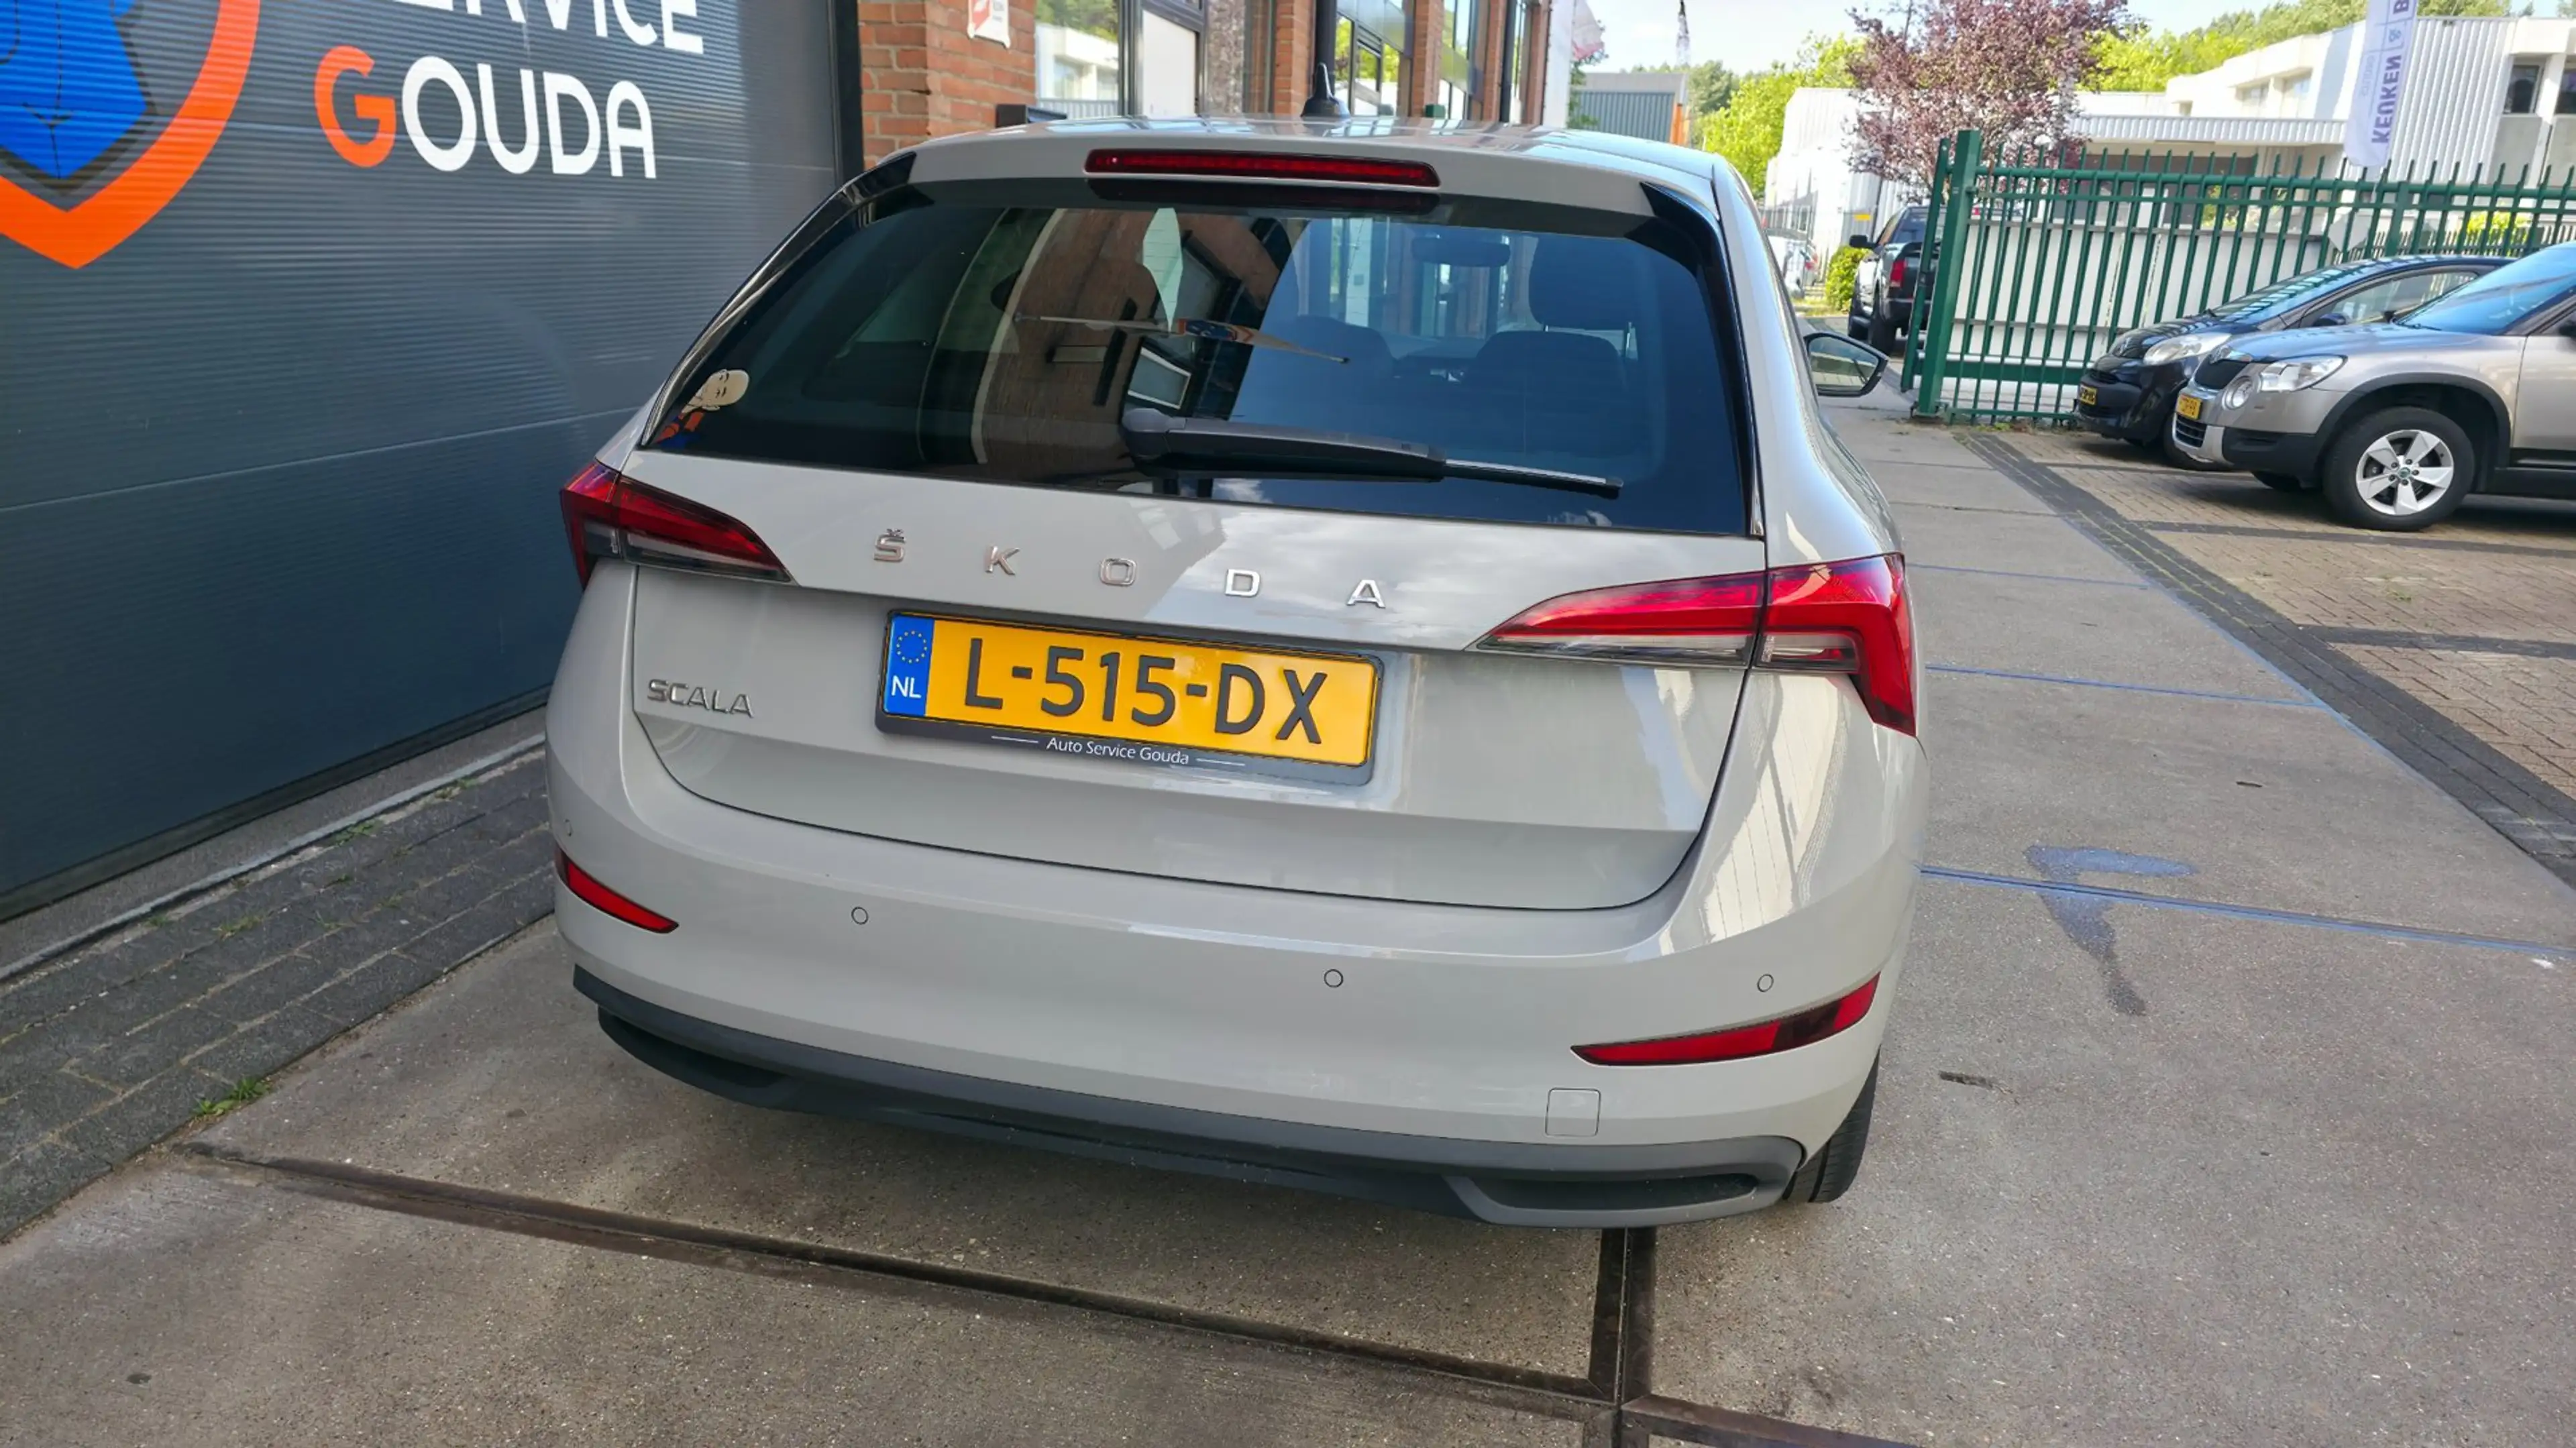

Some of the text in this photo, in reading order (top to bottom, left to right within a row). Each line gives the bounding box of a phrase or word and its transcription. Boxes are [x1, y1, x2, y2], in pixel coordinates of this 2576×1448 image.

[314, 45, 657, 179] GOUDA
[873, 528, 1386, 609] ŠKODA
[647, 679, 754, 718] SCALA
[891, 675, 922, 698] NL
[965, 637, 1328, 744] L-515-DX
[1046, 737, 1189, 765] Auto Service Gouda
